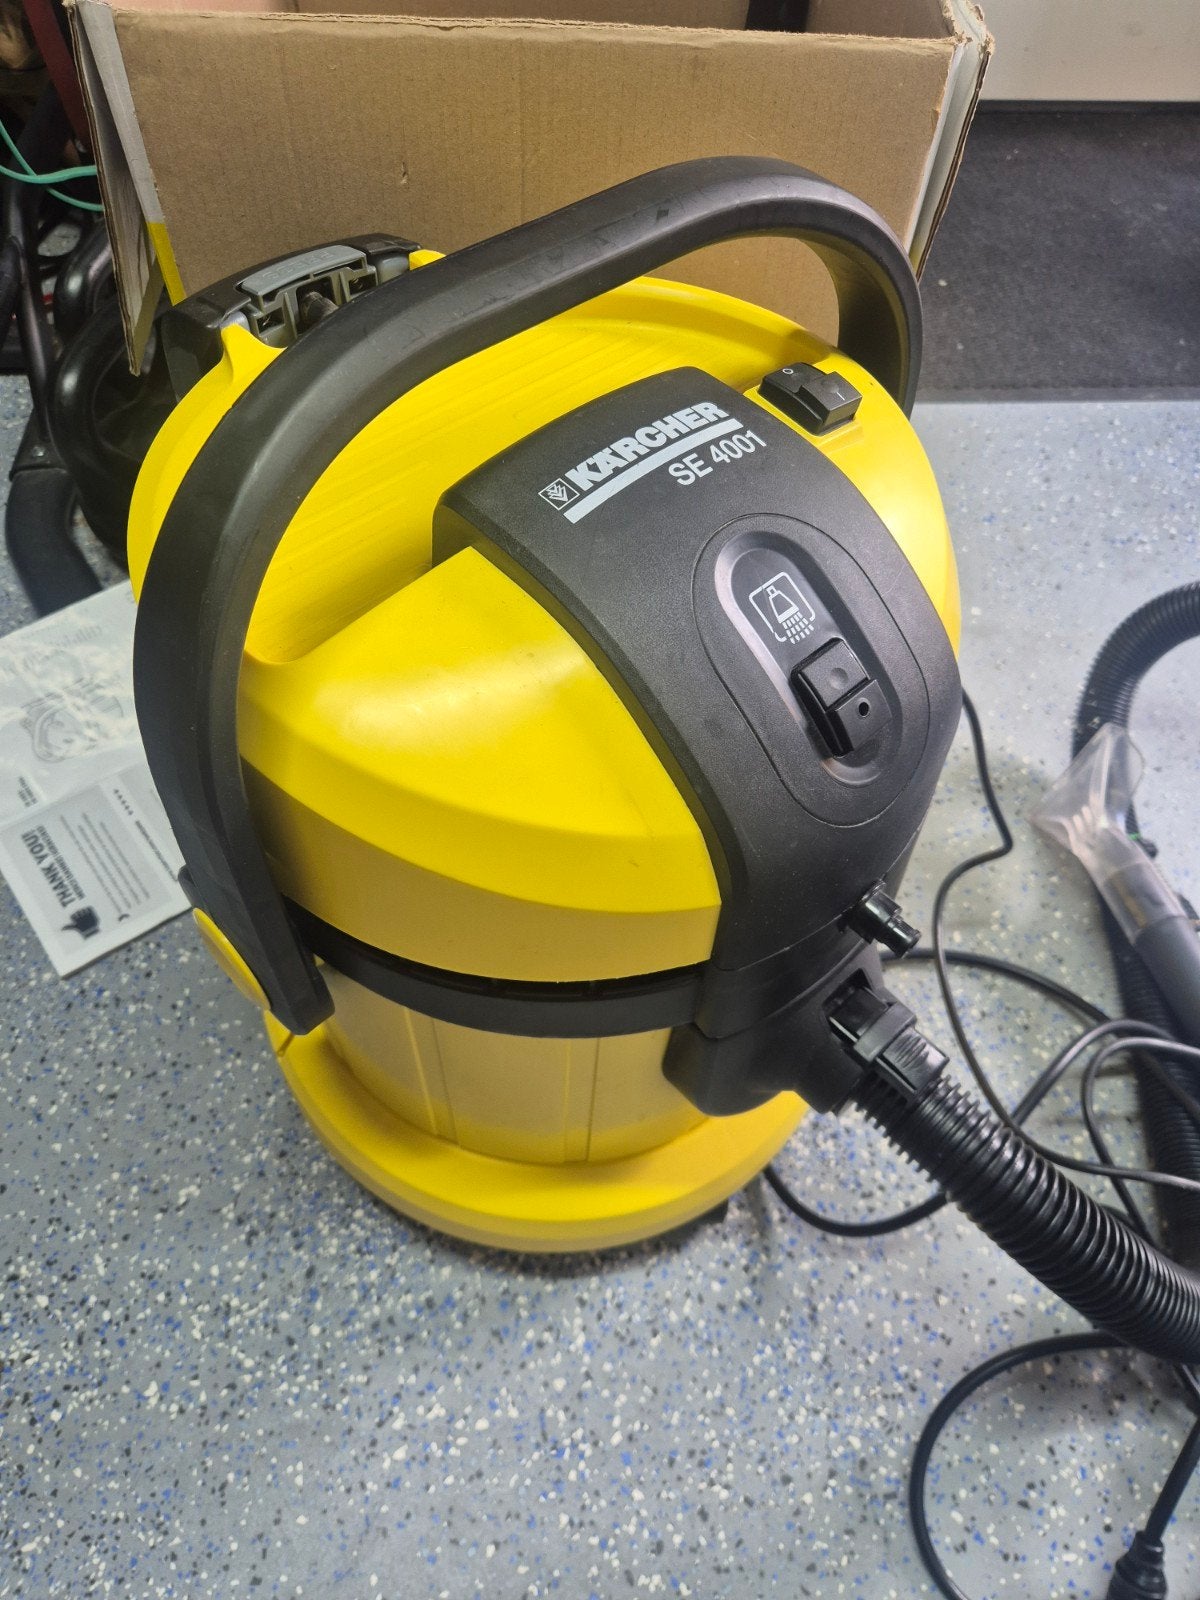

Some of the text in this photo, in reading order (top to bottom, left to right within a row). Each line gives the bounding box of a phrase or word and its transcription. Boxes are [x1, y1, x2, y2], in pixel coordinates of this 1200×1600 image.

[564, 401, 730, 492] KÄRCHER
[668, 429, 767, 486] SE 4001
[41, 862, 76, 908] THANK
